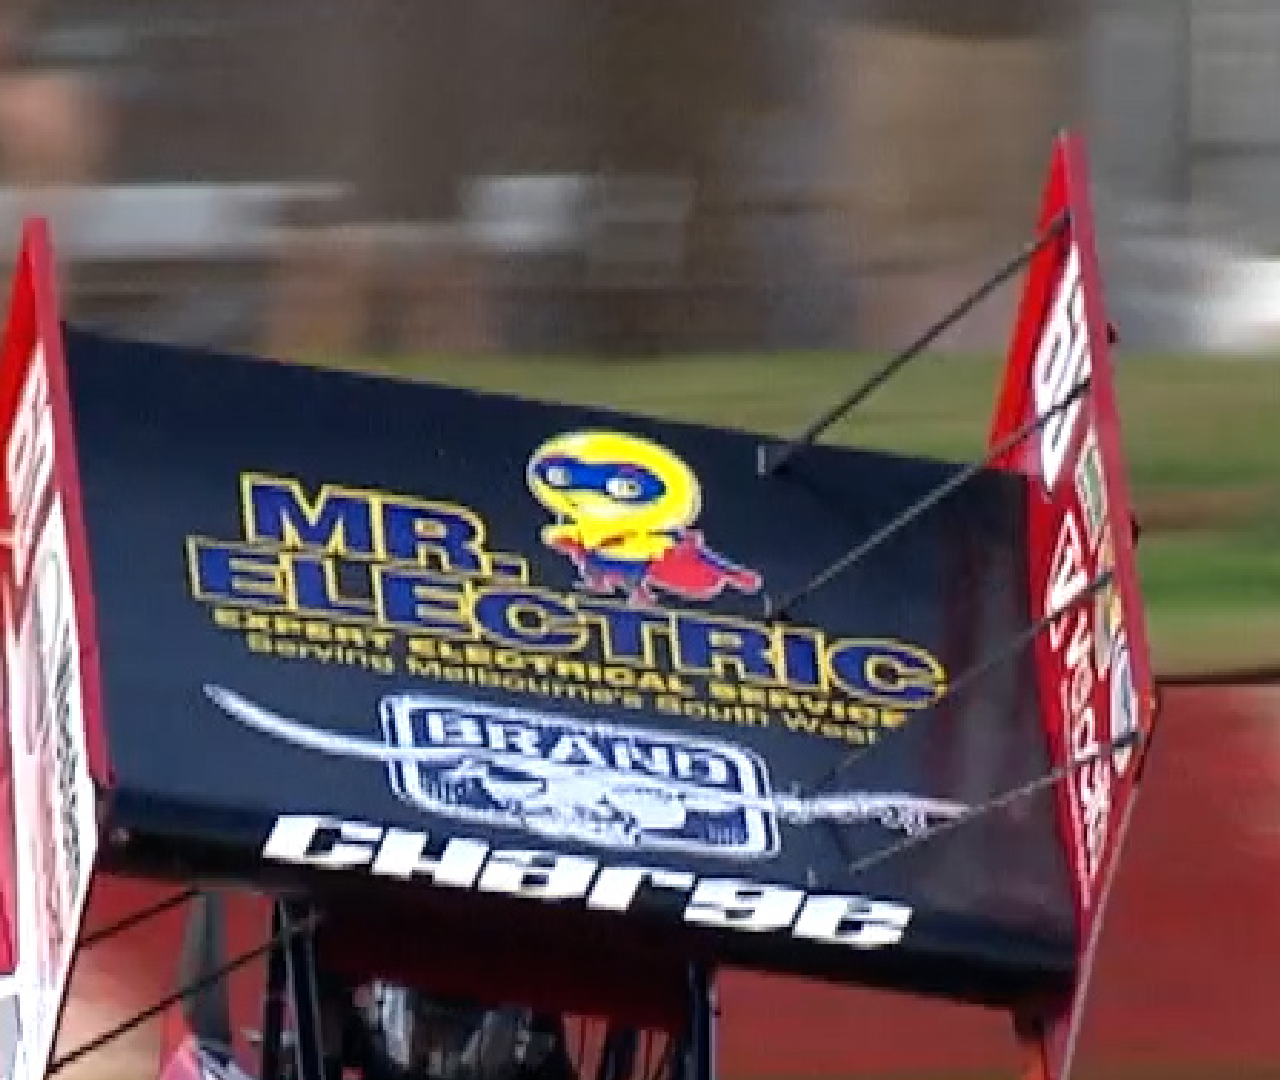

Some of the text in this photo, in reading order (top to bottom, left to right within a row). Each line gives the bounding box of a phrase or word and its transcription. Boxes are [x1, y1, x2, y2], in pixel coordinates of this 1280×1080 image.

[240, 471, 530, 584] MR.
[185, 535, 947, 709] ELECTRIC
[213, 607, 907, 727] EXPERT ELECTRICAL SERVICE
[246, 634, 877, 744] Serving Melbourne's South West
[427, 711, 737, 784] BRAND
